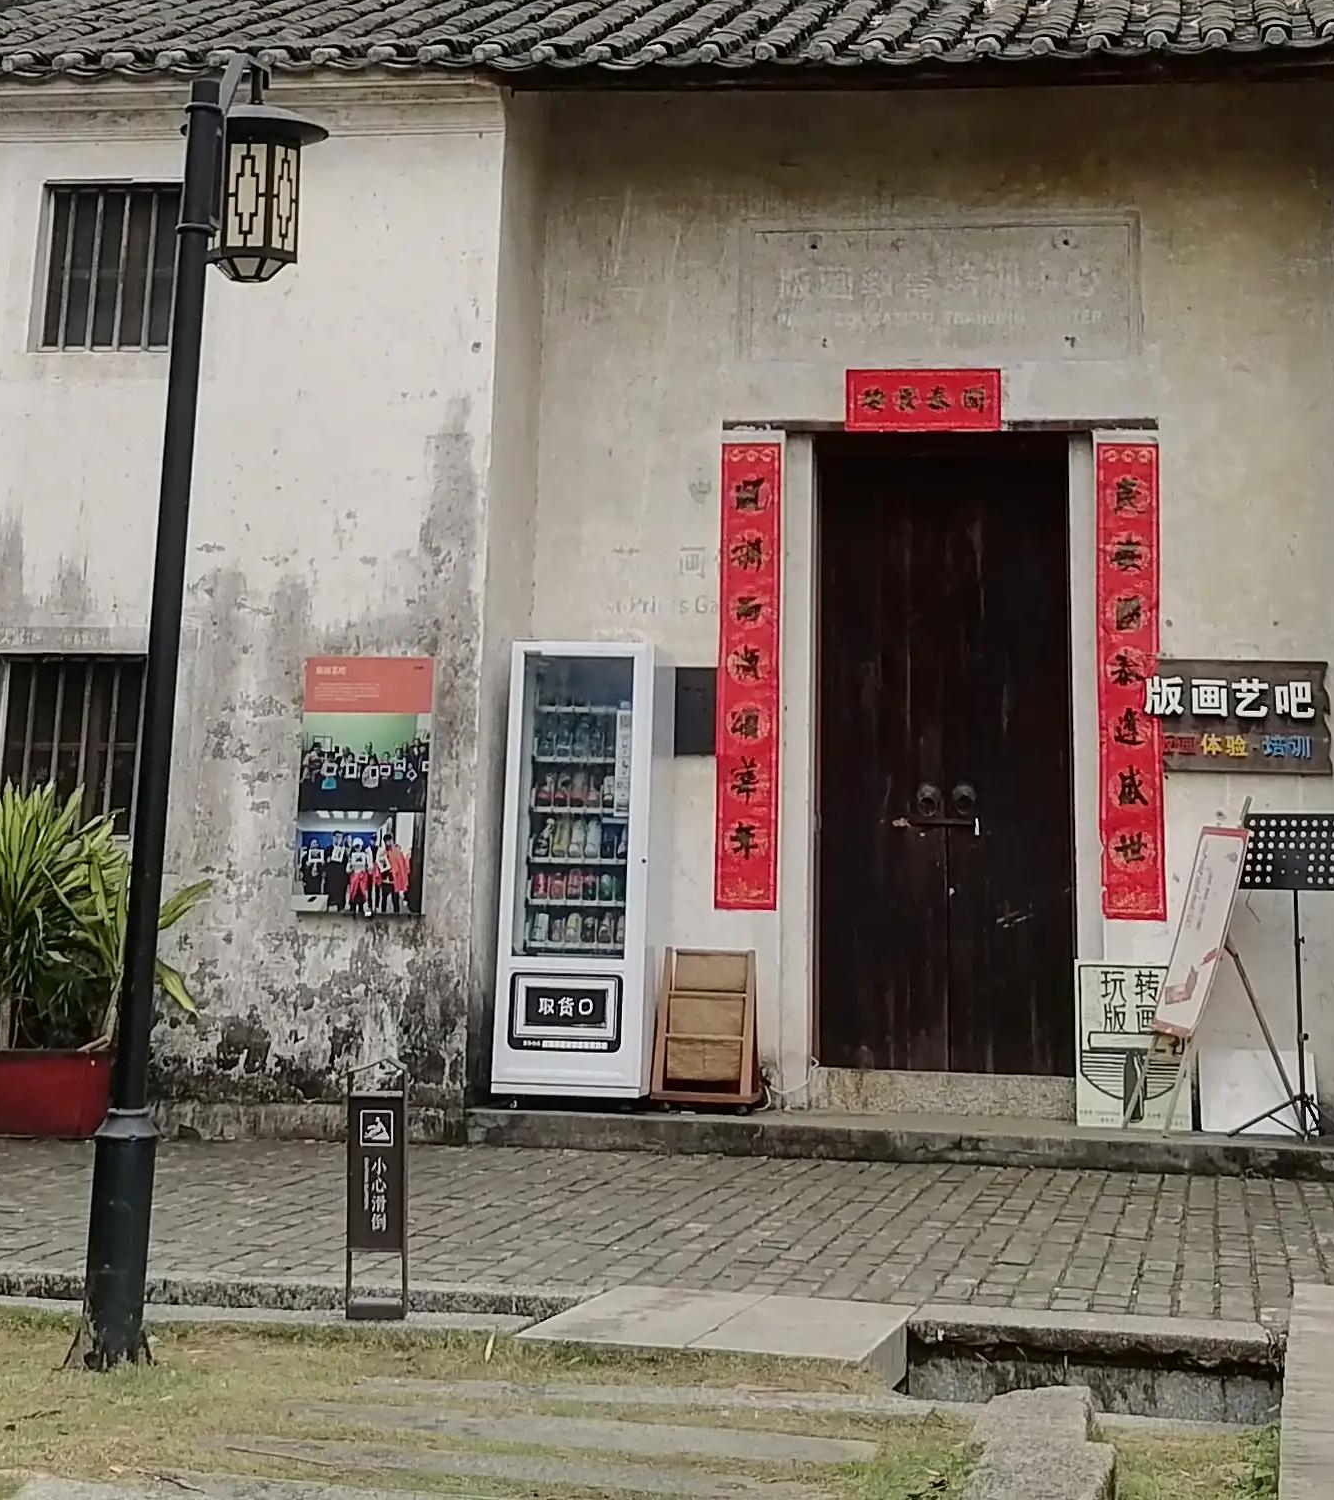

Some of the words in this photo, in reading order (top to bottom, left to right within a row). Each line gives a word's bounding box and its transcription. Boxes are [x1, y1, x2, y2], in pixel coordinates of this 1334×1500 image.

[1144, 675, 1315, 719] 版画艺吧
[538, 997, 593, 1017] 取货口
[371, 1156, 387, 1232] 小心滑倒
